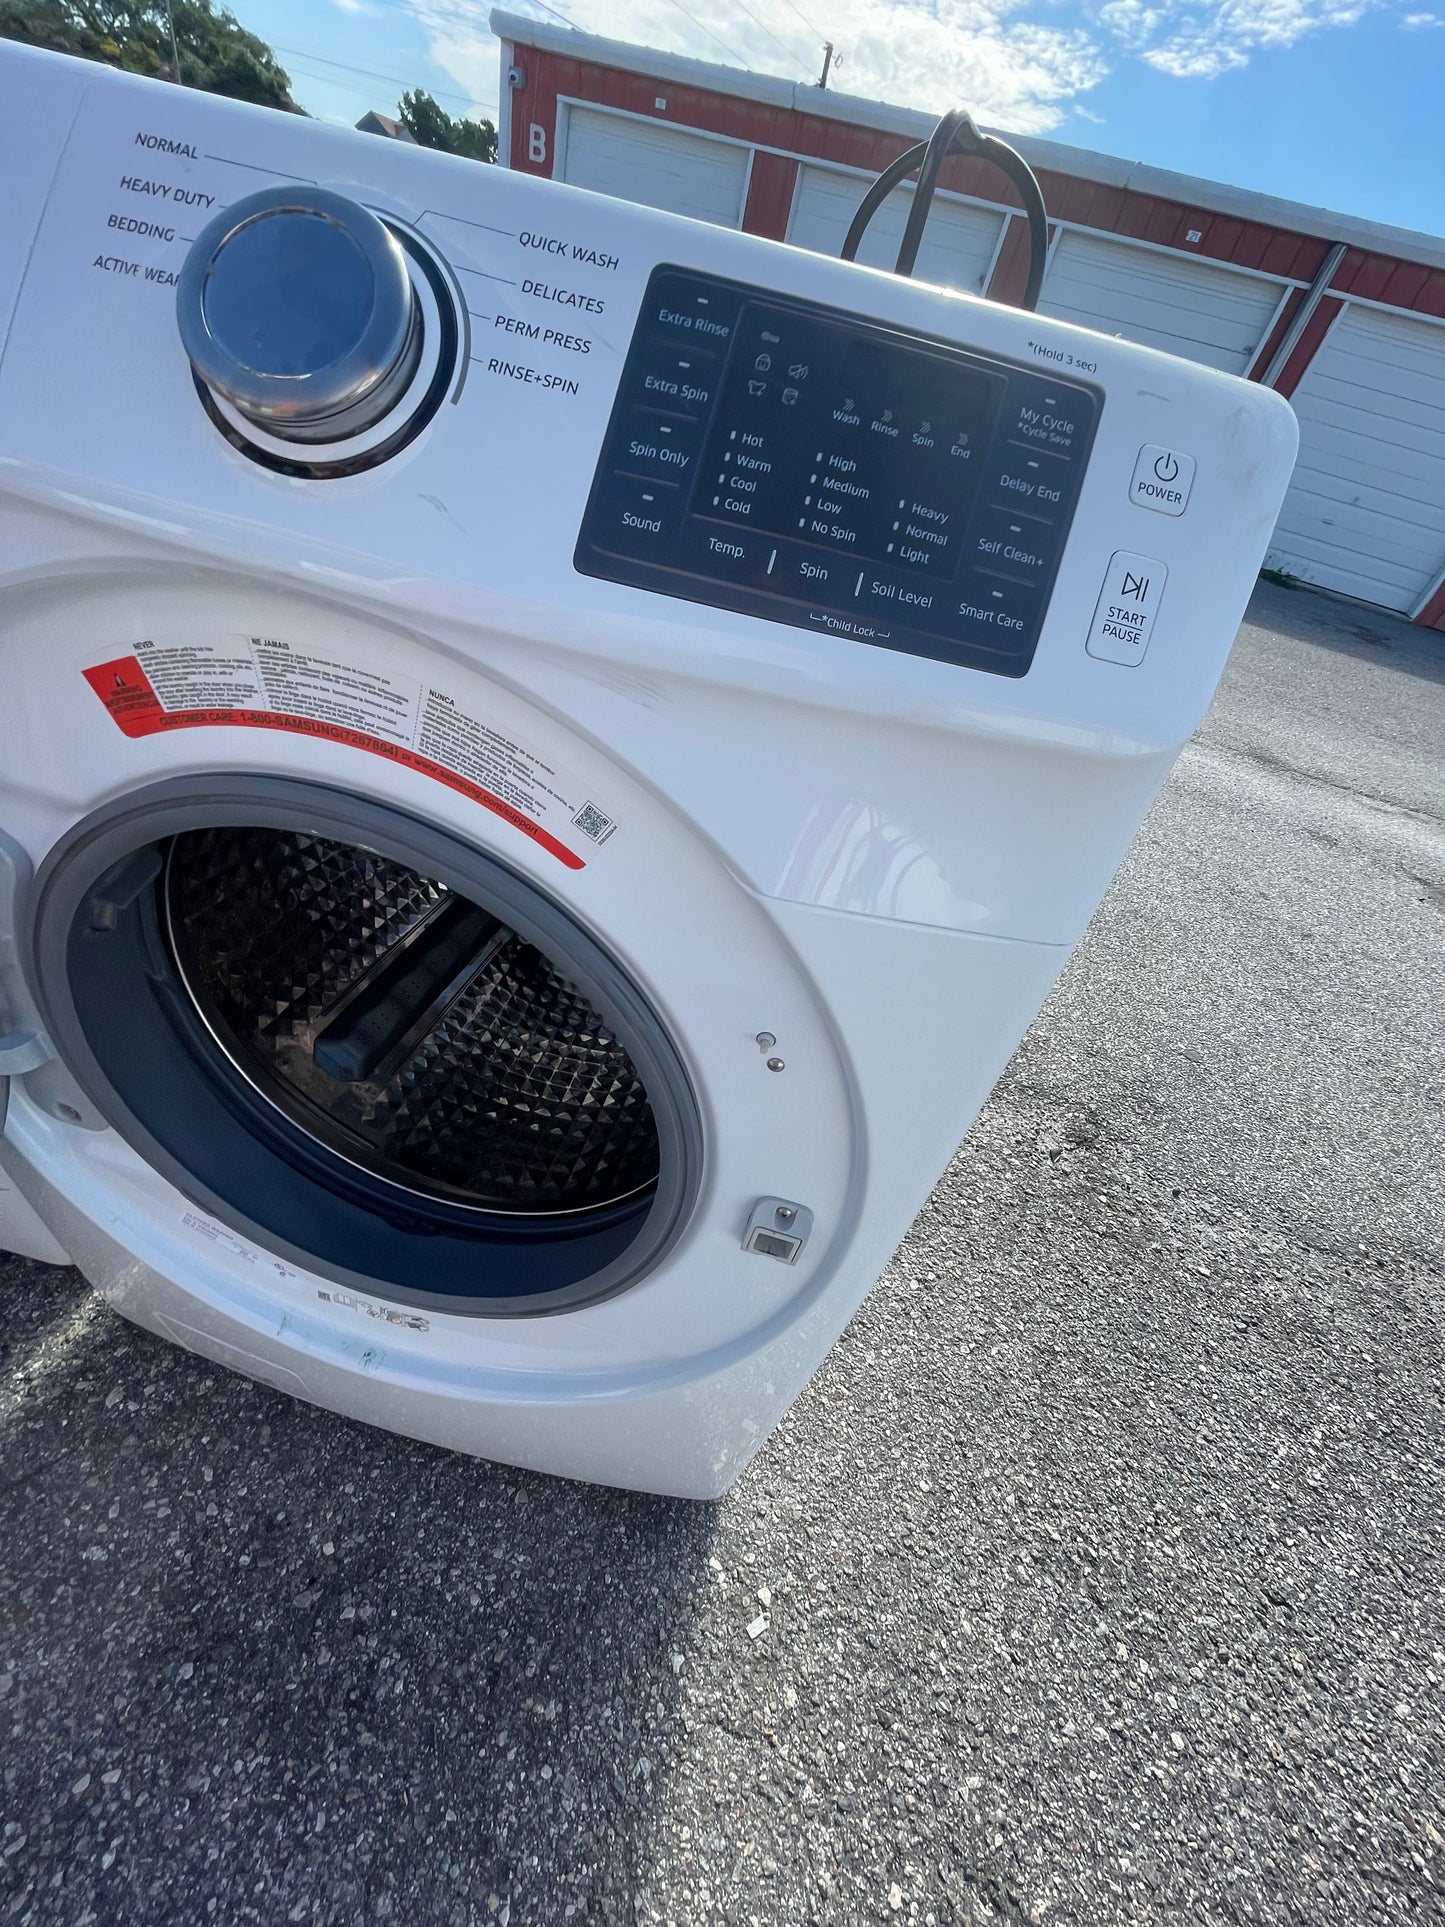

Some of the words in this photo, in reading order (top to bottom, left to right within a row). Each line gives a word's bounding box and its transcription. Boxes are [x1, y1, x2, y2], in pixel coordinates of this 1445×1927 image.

[134, 132, 199, 160] NORMAL
[528, 122, 546, 163] B
[120, 176, 171, 200] HEAVY
[173, 184, 215, 209] DUTY
[107, 214, 175, 242] BEDDING
[517, 231, 569, 257] QUICK
[571, 242, 619, 271] WASH
[93, 255, 140, 276] ACTIVE
[521, 279, 605, 315] DELICATES
[658, 308, 692, 328] Extra
[694, 318, 729, 337] Rinse
[494, 314, 541, 342] PERM
[543, 328, 592, 355] PRESS
[1066, 354, 1074, 365] 3
[1075, 359, 1098, 374] sec)
[487, 357, 579, 396] RINSE+SPIN
[644, 375, 679, 395] Extra
[681, 384, 708, 403] Spin
[832, 409, 861, 426] Wash
[1020, 407, 1040, 424] My
[1042, 414, 1074, 434] Cycle
[870, 420, 899, 437] Rinse
[1049, 431, 1072, 447] Save
[742, 431, 764, 448] Hot
[912, 432, 934, 448] Spin
[629, 440, 659, 461] Spin
[661, 448, 689, 467] Only
[829, 454, 857, 473] High
[951, 446, 970, 460] End
[736, 455, 772, 473] Warm
[730, 476, 757, 493] Cool
[822, 476, 870, 499] Medium
[1000, 475, 1034, 497] Delay
[1036, 485, 1060, 503] End
[1138, 482, 1182, 504] POWER
[724, 498, 750, 514] Cold
[817, 498, 842, 514] Low
[912, 503, 949, 524] Heavy
[622, 513, 661, 533] Sound
[811, 520, 830, 534] No
[831, 525, 856, 543] Spin
[905, 524, 948, 547] Normal
[709, 537, 746, 560] Temp.
[900, 547, 929, 566] Light
[977, 537, 1001, 556] Self
[799, 562, 828, 582] Spin
[871, 581, 897, 600] Soil
[898, 589, 933, 609] Level
[958, 602, 993, 624] Smart
[995, 612, 1024, 631] Care
[1108, 606, 1147, 626] START
[852, 623, 875, 638] Lock
[1102, 624, 1141, 645] PAUSE
[132, 640, 155, 650] NEVER
[251, 637, 263, 646] NE
[264, 640, 290, 651] JAMAIS
[429, 689, 455, 706] NUNCA
[159, 713, 208, 728] CUSTOMER
[401, 751, 413, 763] or
[414, 757, 538, 836] www.samsung.com/support
